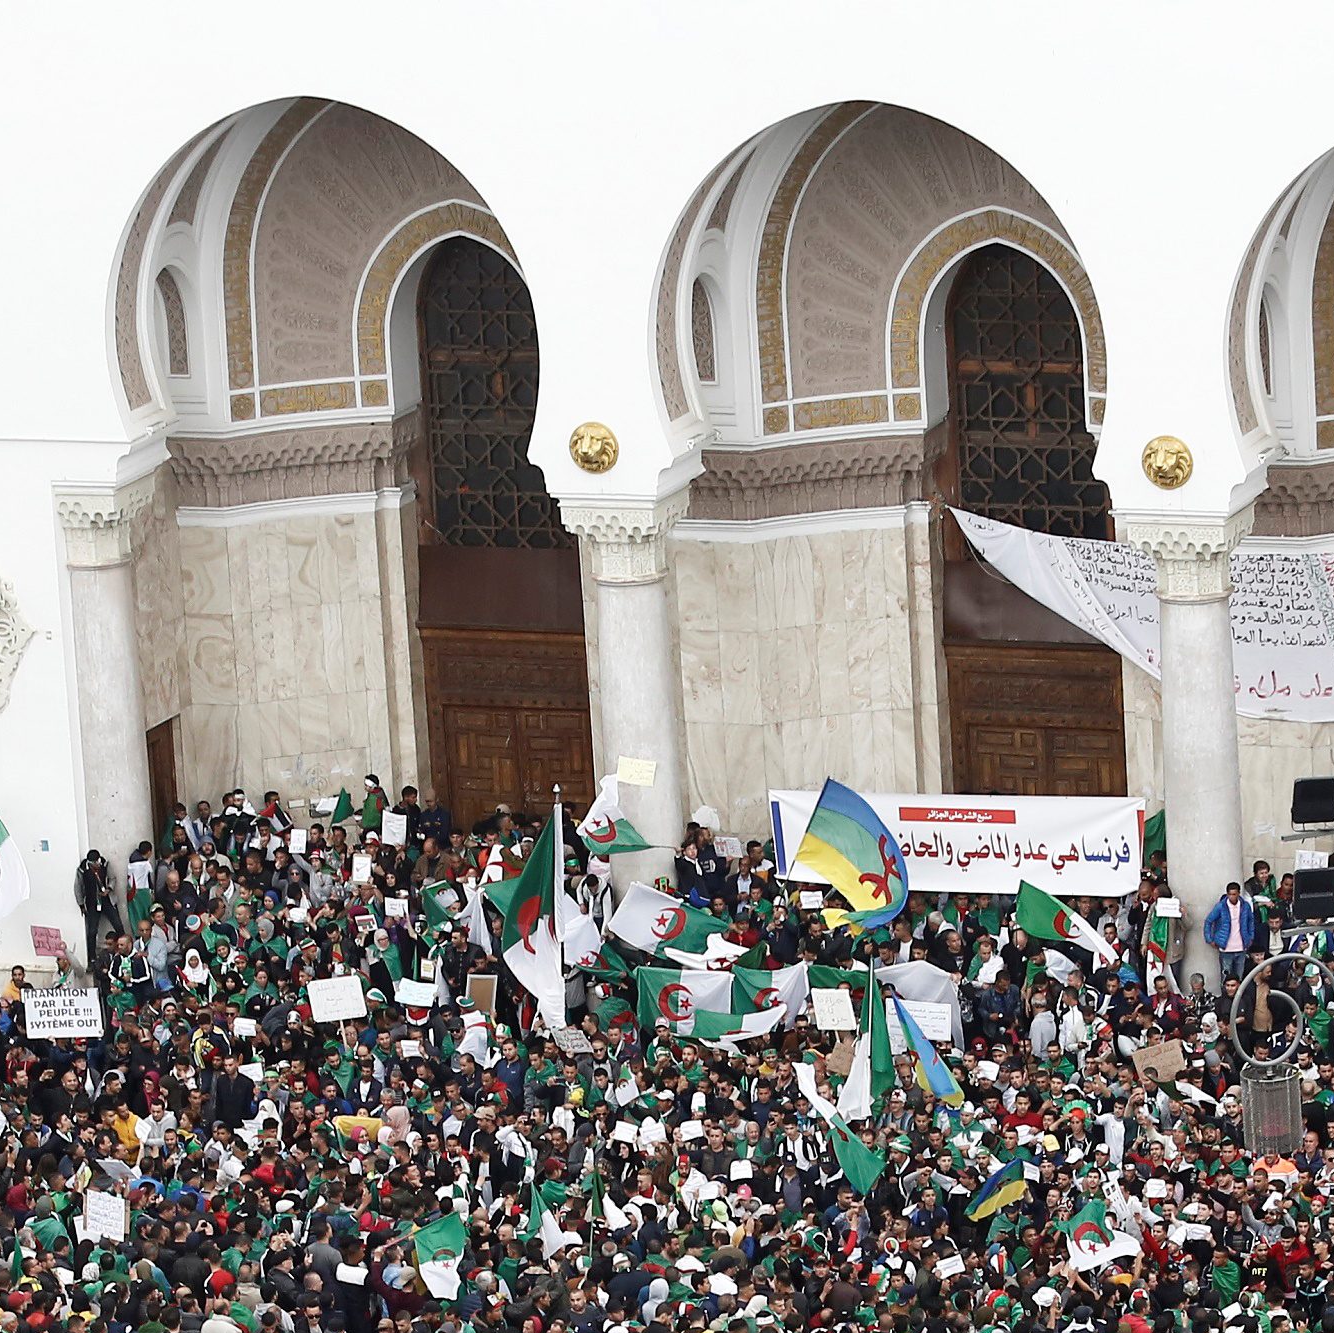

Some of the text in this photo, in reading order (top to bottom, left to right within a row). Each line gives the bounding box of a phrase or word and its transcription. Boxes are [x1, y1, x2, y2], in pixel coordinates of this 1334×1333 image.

[1299, 673, 1333, 699] على
[927, 809, 993, 822] منبع الشر على الجزائر
[898, 830, 1130, 875] فرنسا هي عدو الماضي والحاض
[24, 988, 88, 999] TRANSITION
[33, 998, 75, 1009] PAR LE
[38, 1008, 81, 1018] PEUPLE
[30, 1018, 98, 1029] SYSTÈME OUT
